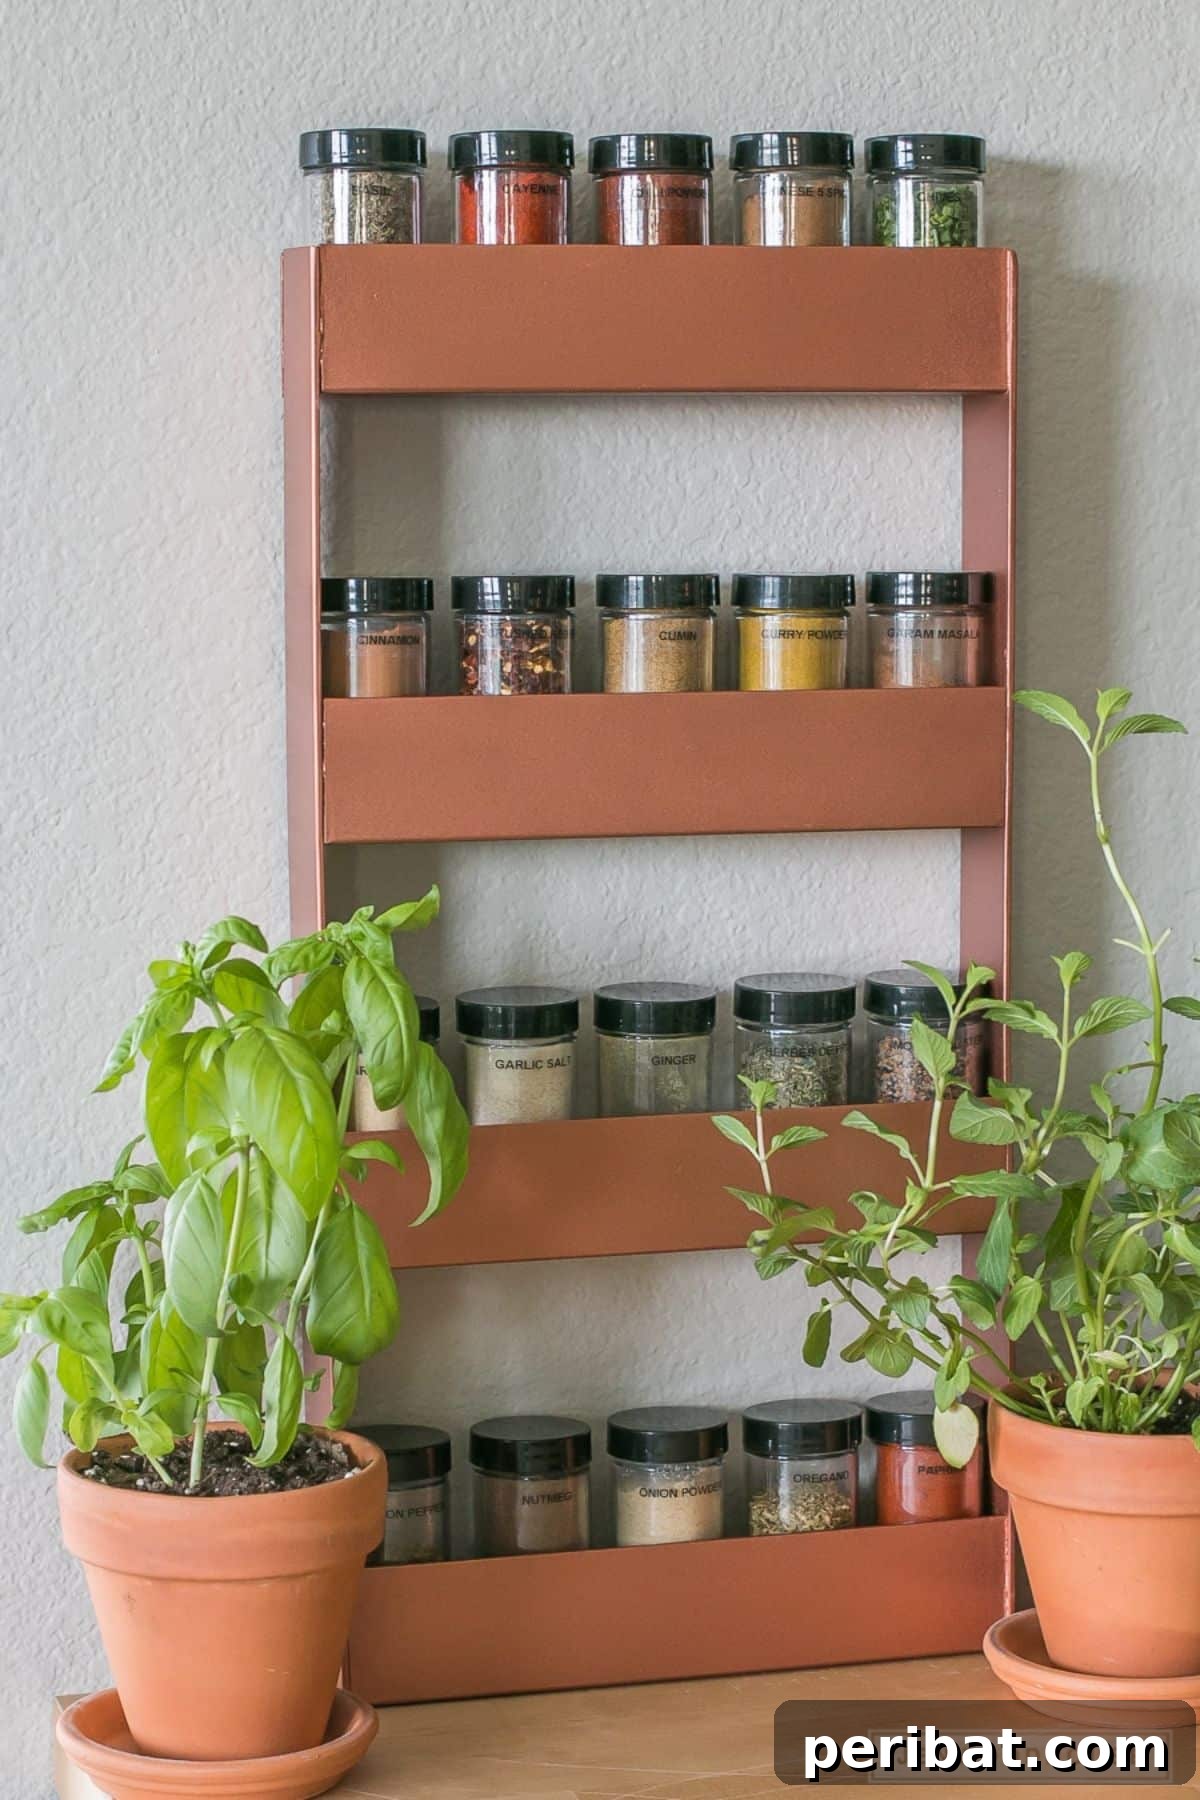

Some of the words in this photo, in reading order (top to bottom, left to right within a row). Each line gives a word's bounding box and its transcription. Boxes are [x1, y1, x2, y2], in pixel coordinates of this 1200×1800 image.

[357, 634, 420, 646] CINNAMON
[658, 630, 697, 641] CUMIN
[761, 629, 804, 641] CURRY
[887, 628, 934, 640] GARAM
[495, 1058, 544, 1071] GARLIC
[546, 1055, 571, 1069] SALT
[651, 1053, 697, 1066] GINGER
[792, 1470, 849, 1484] OREGANO
[521, 1491, 573, 1505] NUTMEG
[639, 1486, 678, 1499] ONION
